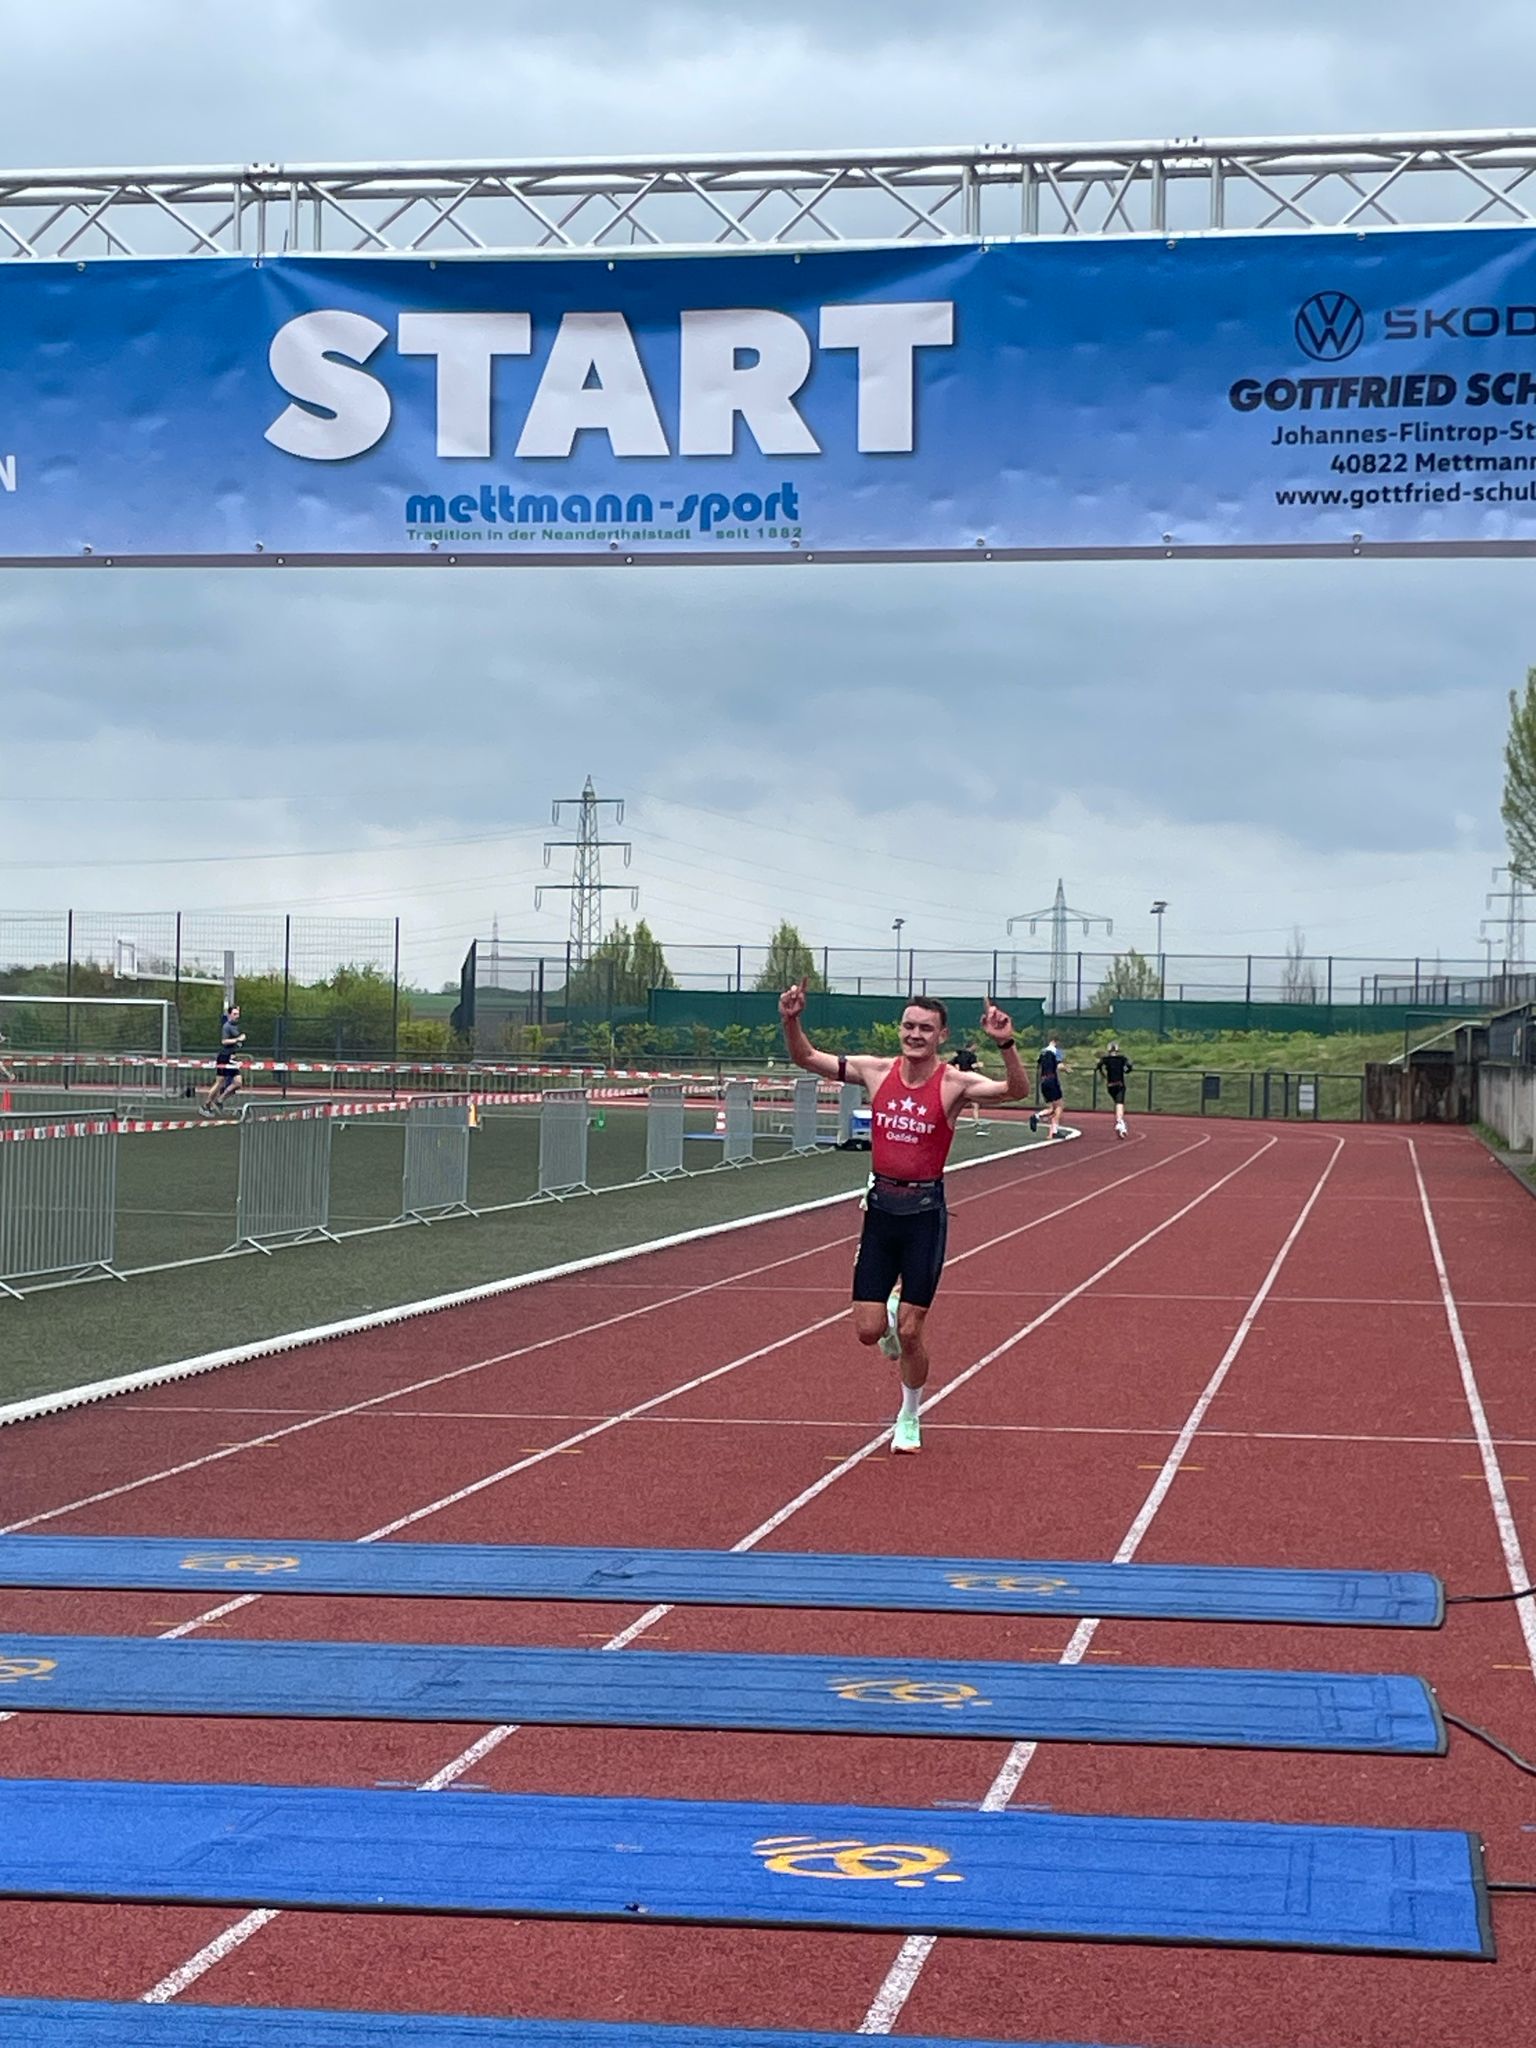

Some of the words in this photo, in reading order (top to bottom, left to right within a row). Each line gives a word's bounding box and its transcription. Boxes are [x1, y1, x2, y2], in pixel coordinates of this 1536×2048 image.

[264, 301, 954, 461] START
[1229, 374, 1457, 412] GOTTFRIED
[1271, 420, 1536, 446] Johannes-Flintrop-St
[1330, 453, 1408, 474] 40822
[406, 482, 799, 532] mettmann-sport
[1275, 481, 1536, 509] www.gottfried-schul
[406, 529, 482, 541] Tradition
[488, 529, 503, 541] in
[508, 528, 536, 541] der
[542, 528, 691, 541] Neanderthalstadt
[716, 527, 750, 540] seit
[757, 526, 802, 540] 1882
[876, 1112, 935, 1134] TriStar
